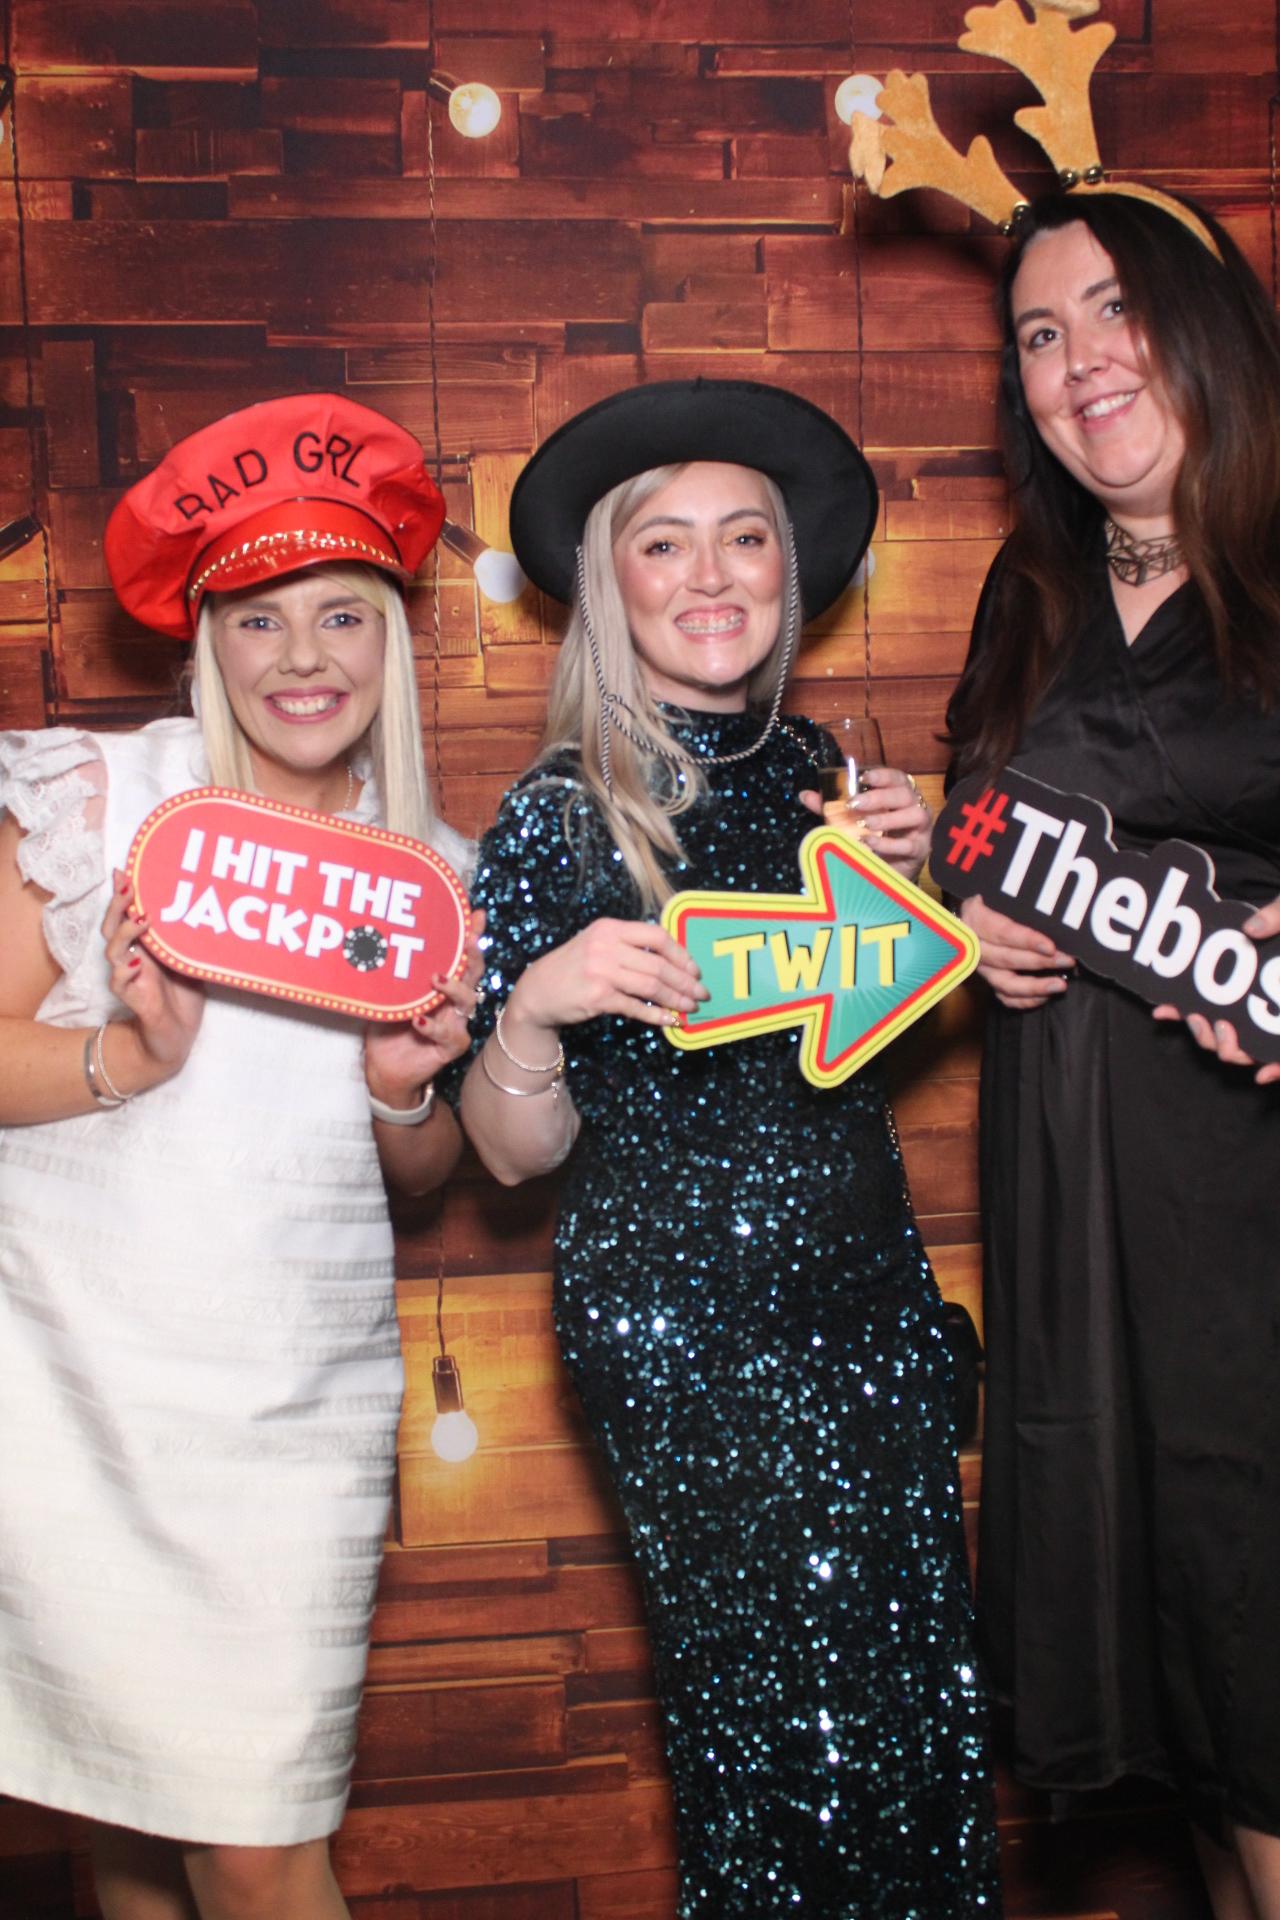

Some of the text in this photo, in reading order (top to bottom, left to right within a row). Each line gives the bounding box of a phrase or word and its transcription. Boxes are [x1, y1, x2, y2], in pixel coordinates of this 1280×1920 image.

[293, 431, 364, 488] GRL
[181, 828, 421, 928] I HIT THE
[160, 880, 425, 980] JACKPOT
[712, 921, 910, 1000] TWIT
